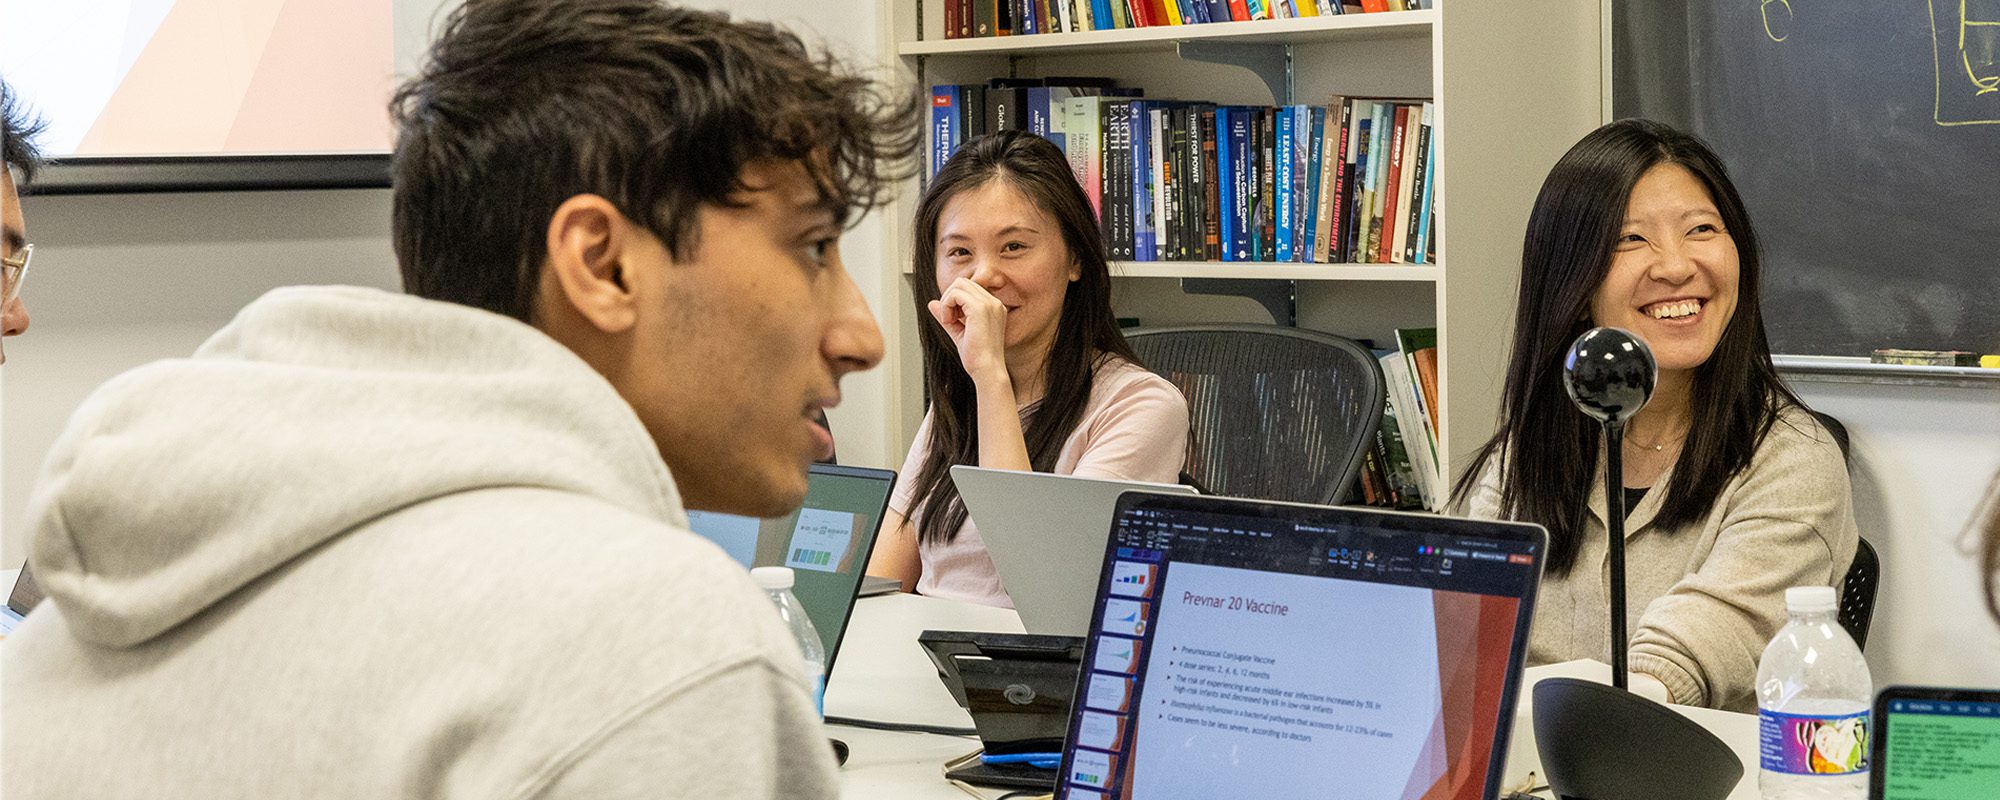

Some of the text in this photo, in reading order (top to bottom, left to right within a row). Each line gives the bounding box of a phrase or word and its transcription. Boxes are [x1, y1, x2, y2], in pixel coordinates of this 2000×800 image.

[998, 104, 1006, 132] Globa
[1110, 104, 1119, 149] EARTH
[1121, 104, 1130, 149] EARTH
[1282, 134, 1290, 190] LEAST-COST
[1322, 172, 1331, 203] Sustainable
[1281, 192, 1289, 229] ENERGY
[1331, 194, 1341, 250] ENVIRONMENT
[1182, 591, 1289, 616] Prevnar 20 Vaccine
[1181, 646, 1275, 665] Pneumococcal Conjugate Vaccine
[1249, 671, 1270, 679] months
[1173, 685, 1197, 694] high-risk
[1199, 689, 1219, 698] infants
[1232, 693, 1261, 704] decreased
[1262, 698, 1269, 706] by
[1312, 705, 1333, 714] infants
[1176, 674, 1186, 682] The
[1207, 679, 1243, 692] experiencing
[1262, 687, 1282, 696] middle
[1295, 692, 1324, 702] infections
[1326, 696, 1355, 706] increased
[1356, 700, 1363, 709] by
[1167, 714, 1183, 722] Cases
[1229, 724, 1250, 734] severe,
[1252, 727, 1280, 739] according
[1289, 732, 1311, 742] doctors
[1244, 710, 1268, 720] bacterial
[1269, 715, 1295, 725] pathogen
[1309, 721, 1334, 729] accounts
